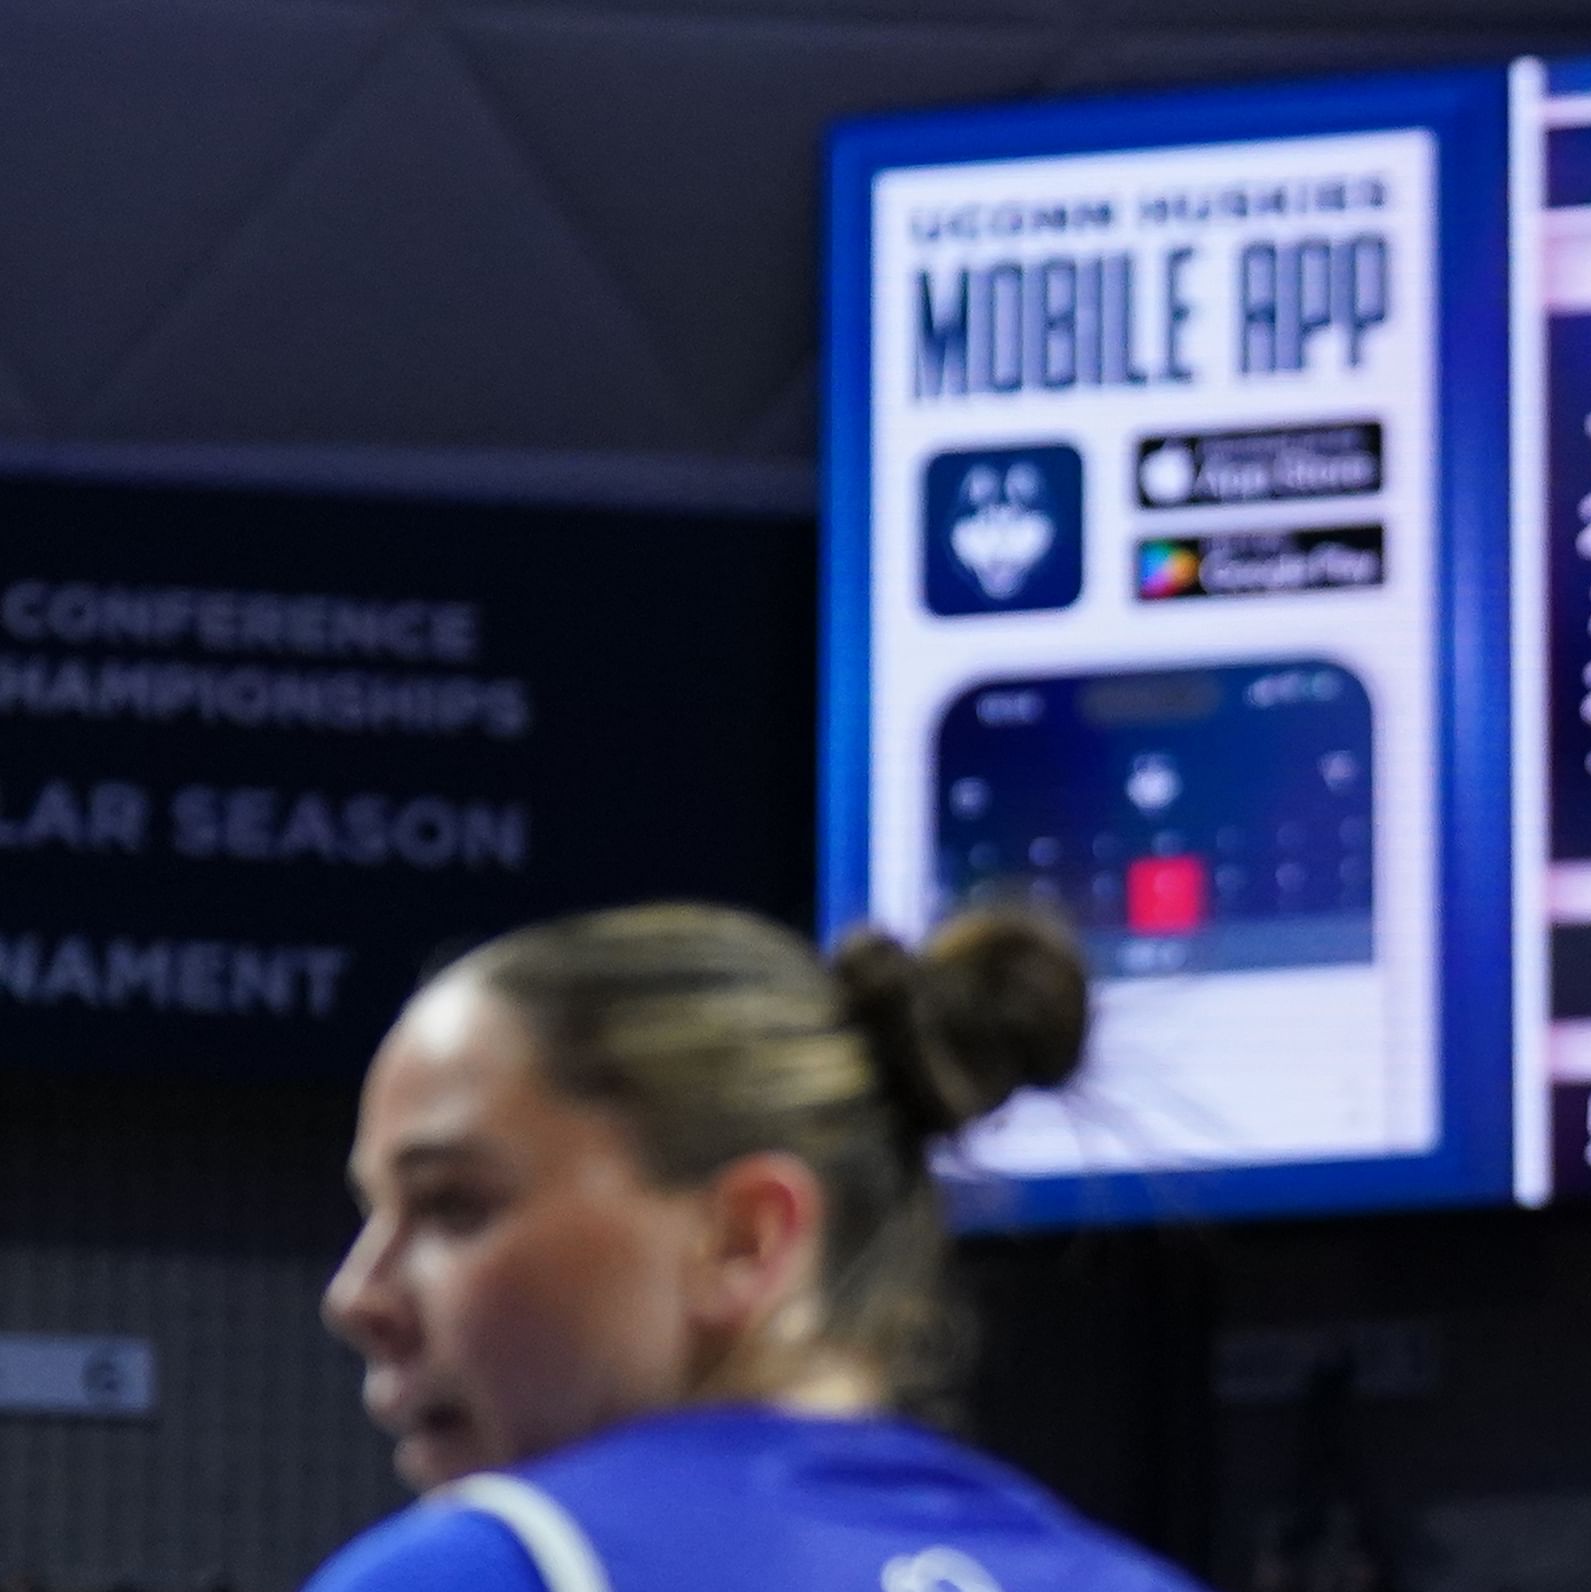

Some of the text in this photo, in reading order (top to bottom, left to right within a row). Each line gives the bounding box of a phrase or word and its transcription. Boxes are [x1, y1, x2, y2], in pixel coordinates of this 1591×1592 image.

[911, 177, 1386, 242] UCONN HUSKIES
[915, 230, 1386, 400] MOBILE APP
[2, 579, 478, 662] CONFERENCE
[170, 784, 529, 868] SEASON
